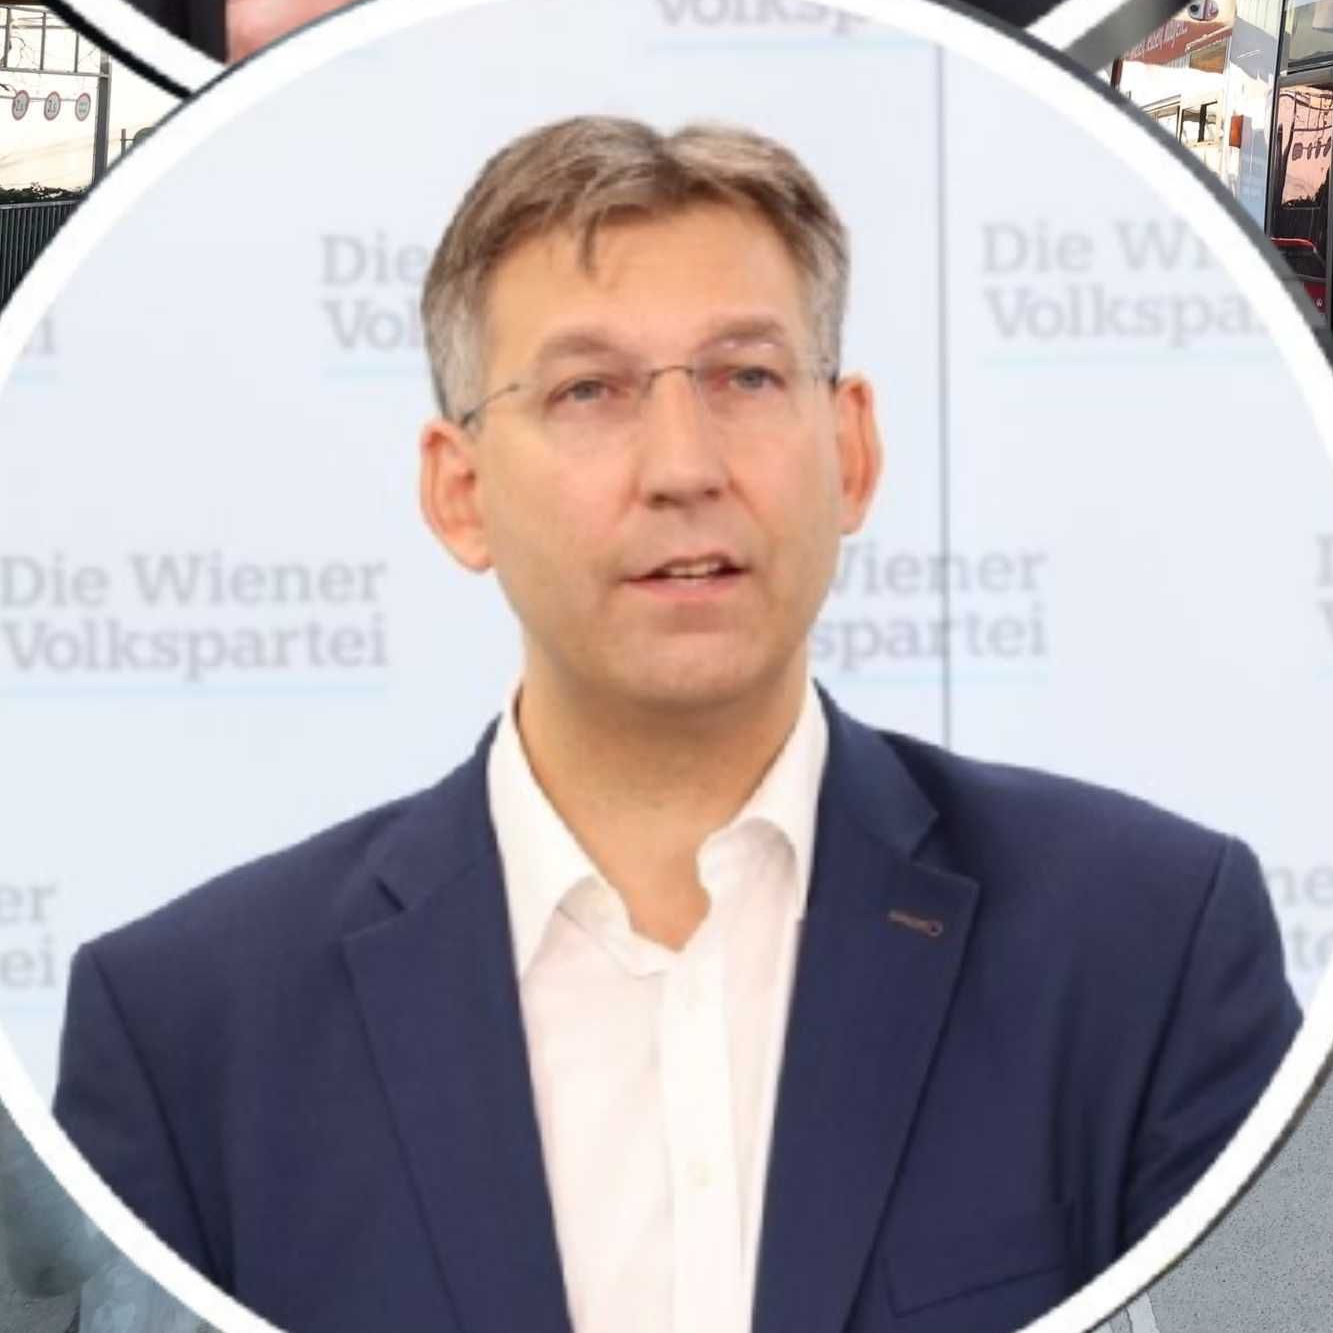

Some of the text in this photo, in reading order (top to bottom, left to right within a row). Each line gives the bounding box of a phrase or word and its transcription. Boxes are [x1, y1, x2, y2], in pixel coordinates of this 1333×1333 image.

[980, 219, 1095, 274] Die
[0, 548, 389, 610] Die Wiener
[0, 610, 391, 686] Volkspartei
